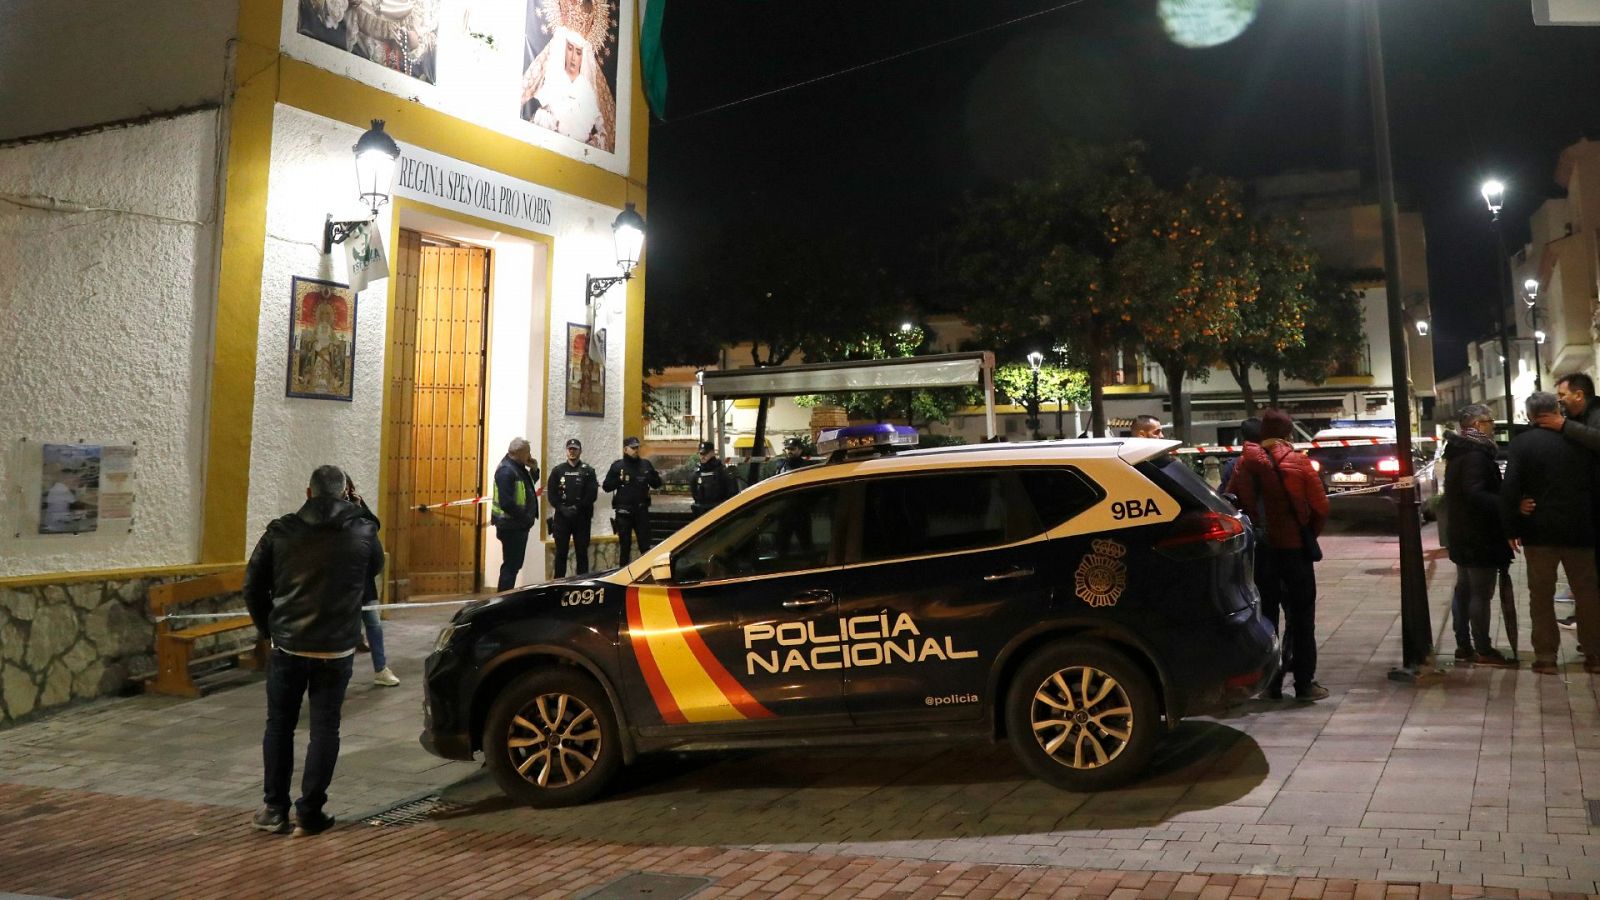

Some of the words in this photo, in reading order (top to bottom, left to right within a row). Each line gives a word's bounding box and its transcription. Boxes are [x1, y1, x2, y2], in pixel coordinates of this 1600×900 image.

[398, 156, 444, 198] REGINA
[446, 170, 474, 204] SPES
[474, 178, 497, 212] ORA
[499, 185, 520, 218] PRO
[521, 192, 552, 226] NOBIS
[1111, 498, 1162, 520] 9BA
[568, 587, 605, 606] 091
[743, 608, 921, 649] POLICÍA
[746, 635, 979, 675] NACIONAL
[924, 693, 979, 708] @policia
